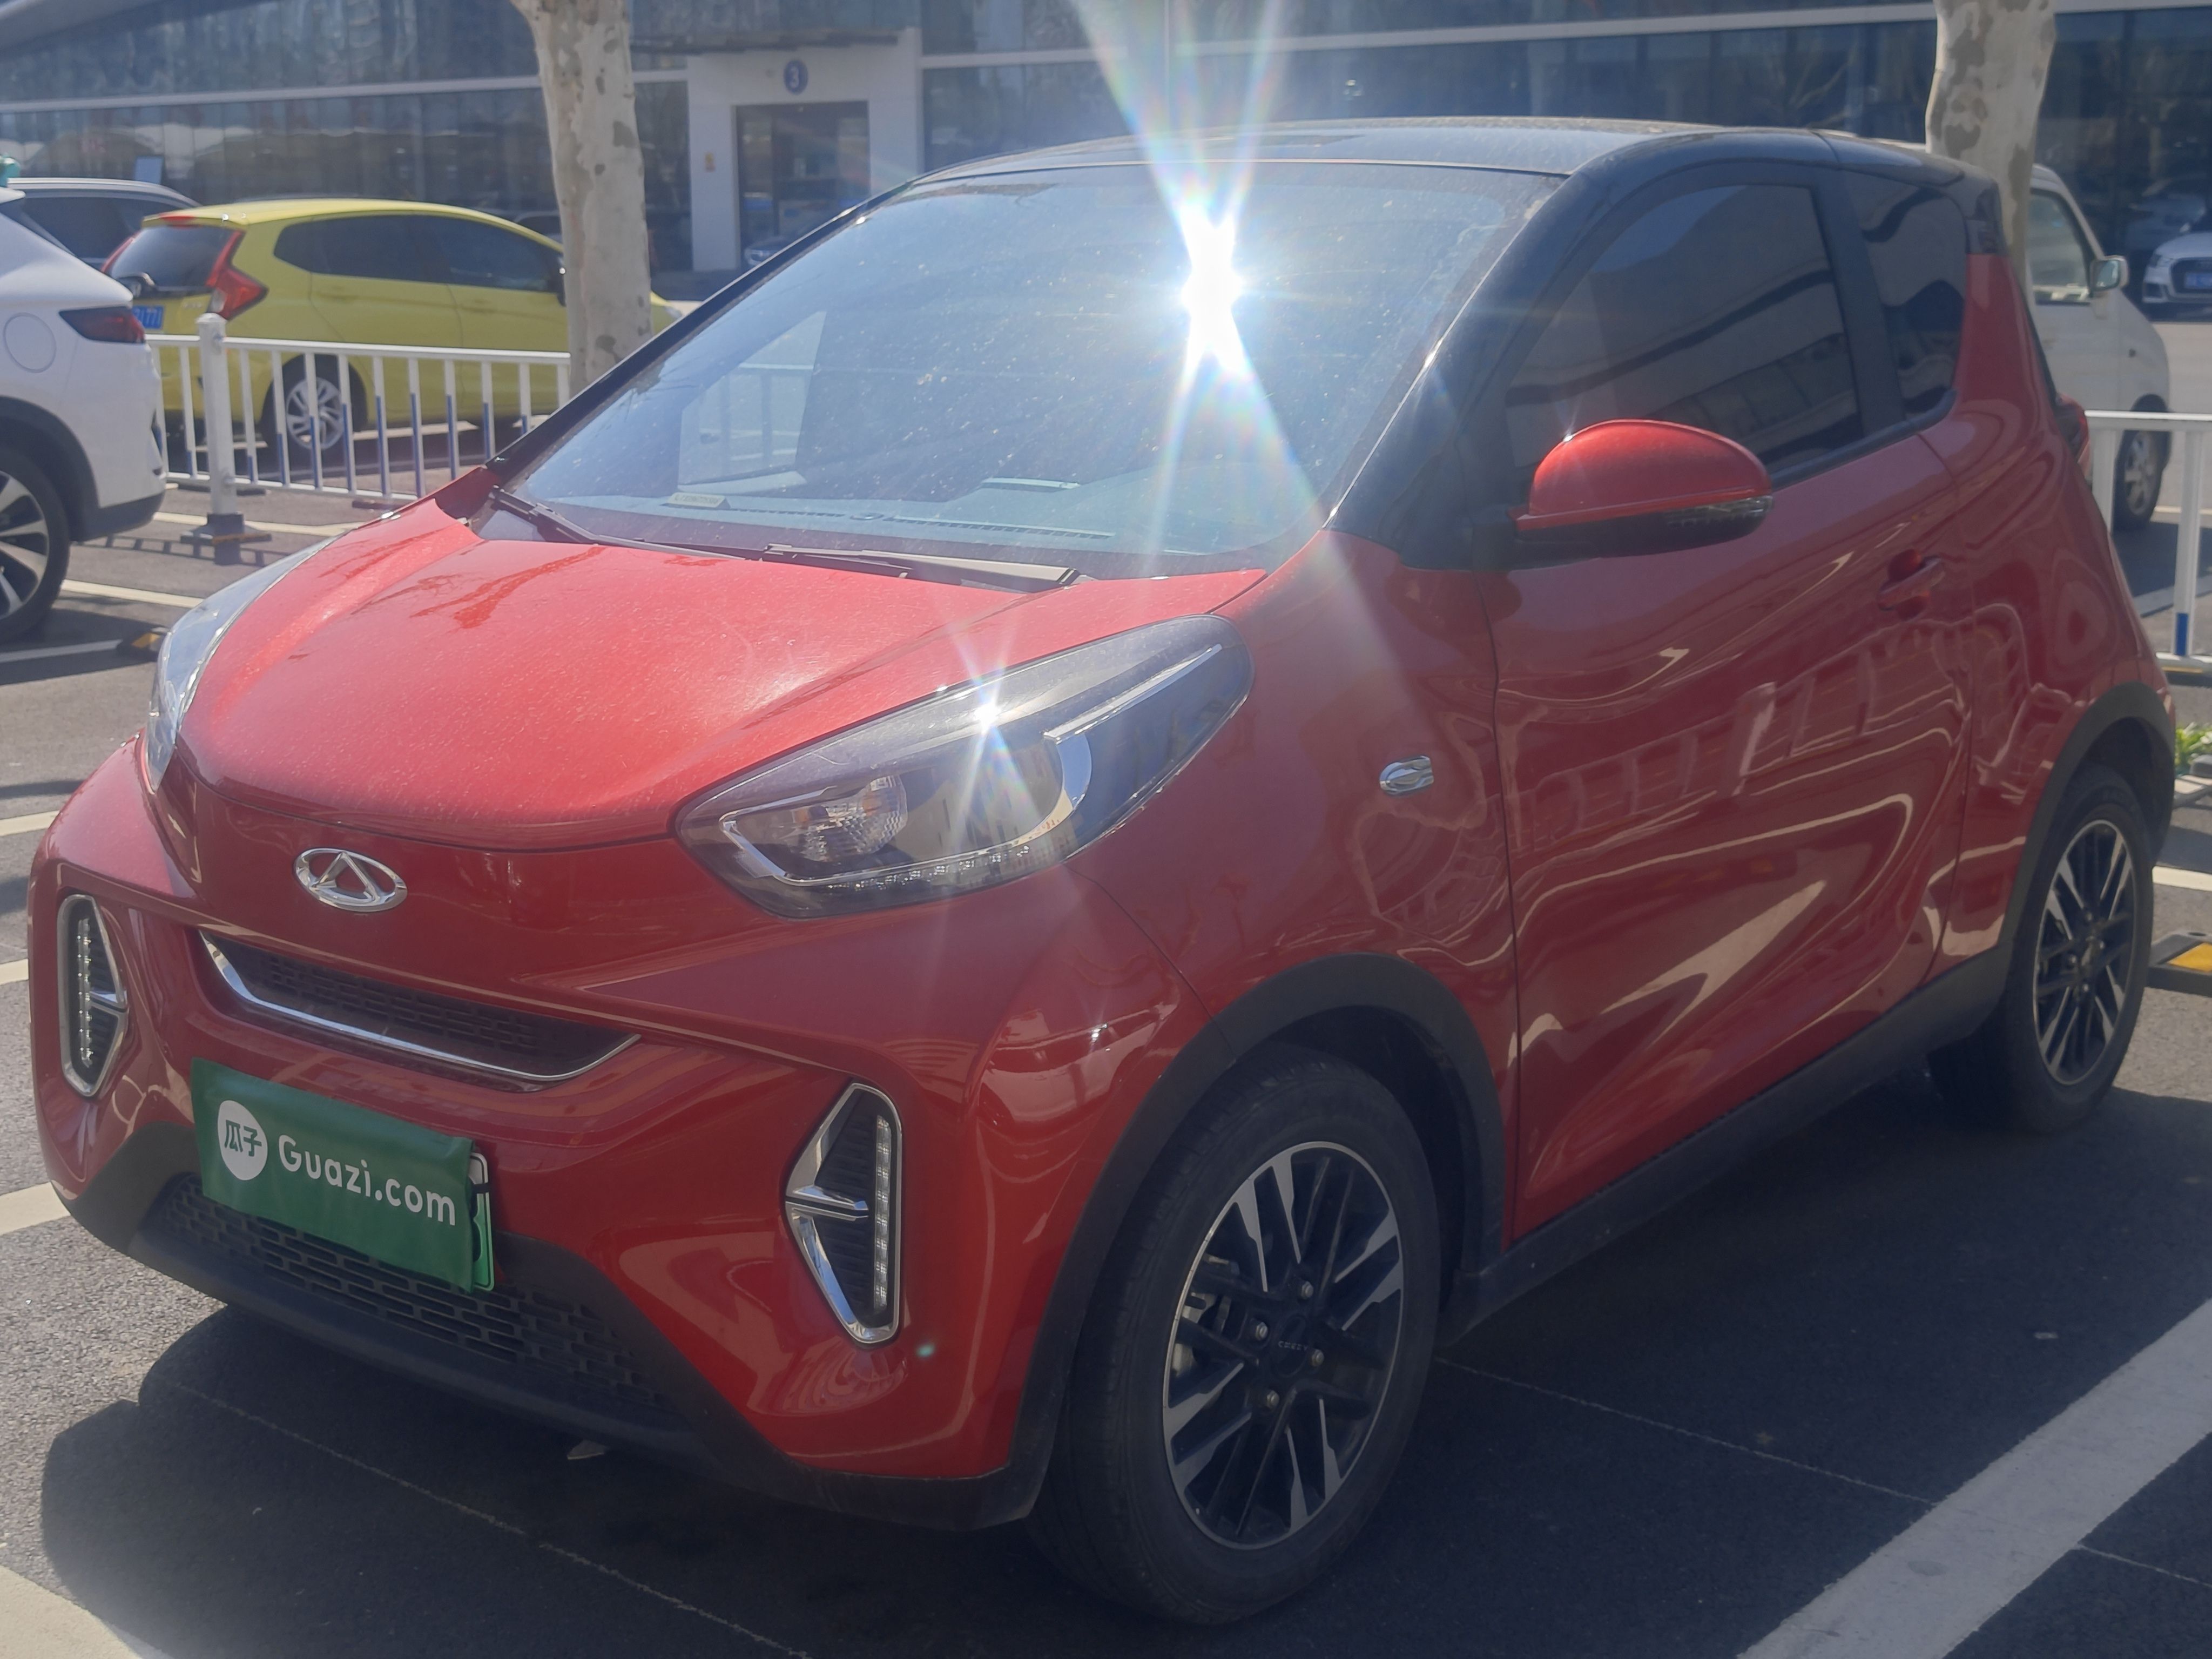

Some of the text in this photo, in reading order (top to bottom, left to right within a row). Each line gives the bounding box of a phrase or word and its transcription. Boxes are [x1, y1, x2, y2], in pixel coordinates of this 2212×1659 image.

[790, 66, 800, 88] 3
[224, 1119, 262, 1157] 瓜子
[279, 1135, 455, 1226] Guazi.com
